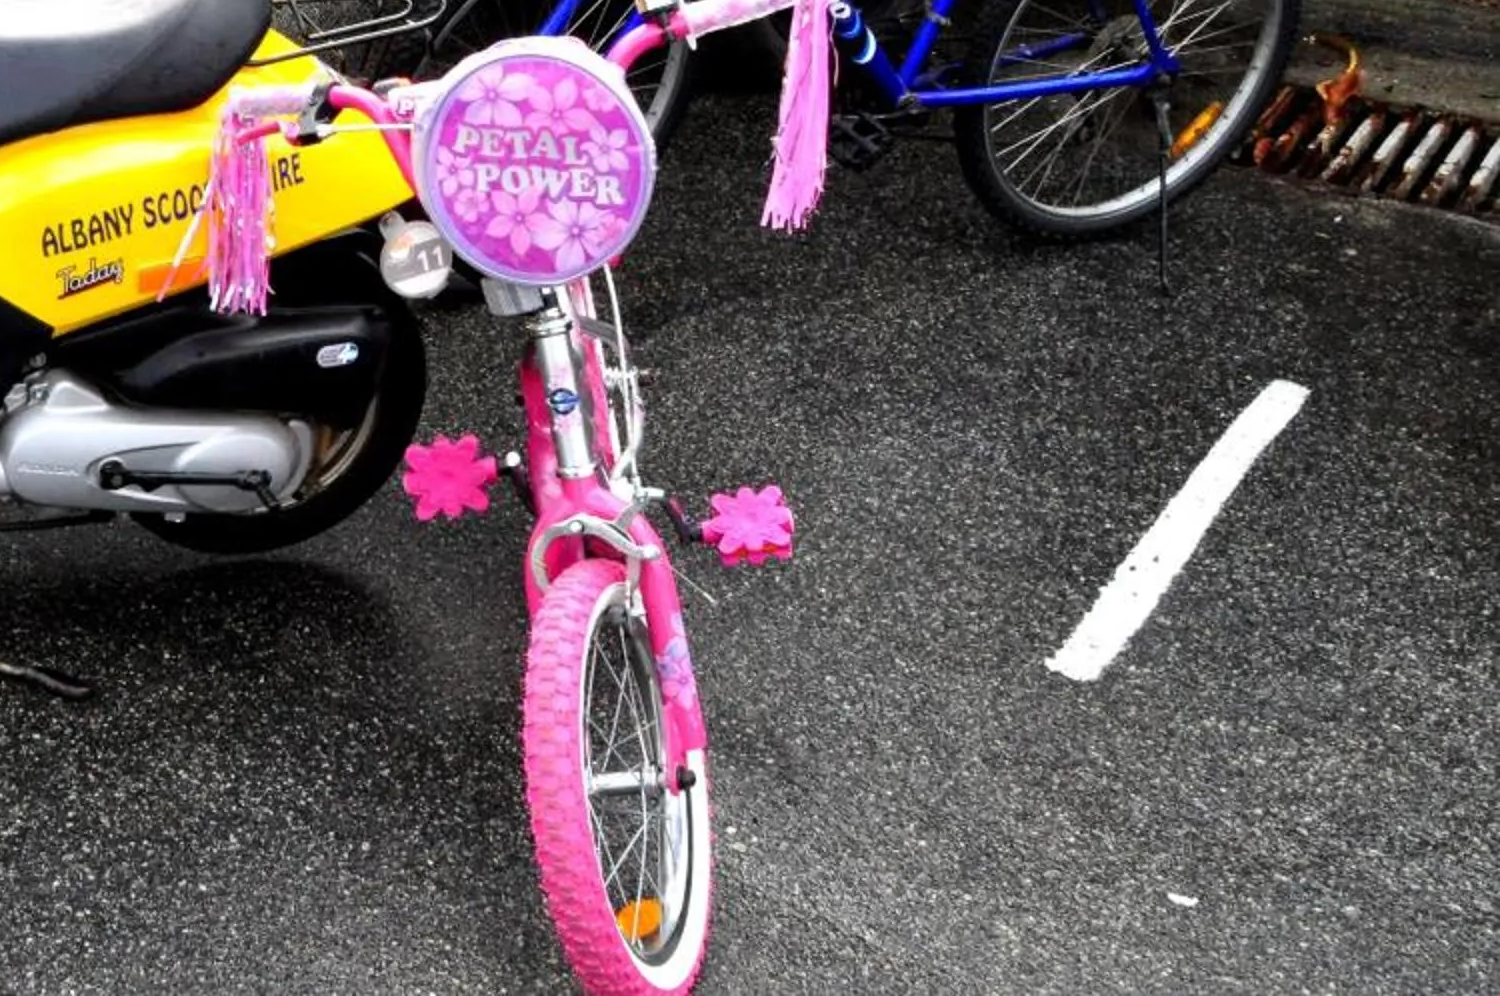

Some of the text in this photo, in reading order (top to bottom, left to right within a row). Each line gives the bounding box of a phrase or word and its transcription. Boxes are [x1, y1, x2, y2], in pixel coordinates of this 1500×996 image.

[452, 124, 589, 165] PETAL
[474, 161, 626, 206] POWER
[42, 204, 133, 257] ALBANY
[271, 153, 304, 193] IRE
[56, 258, 124, 294] Today
[417, 246, 445, 272] 11
